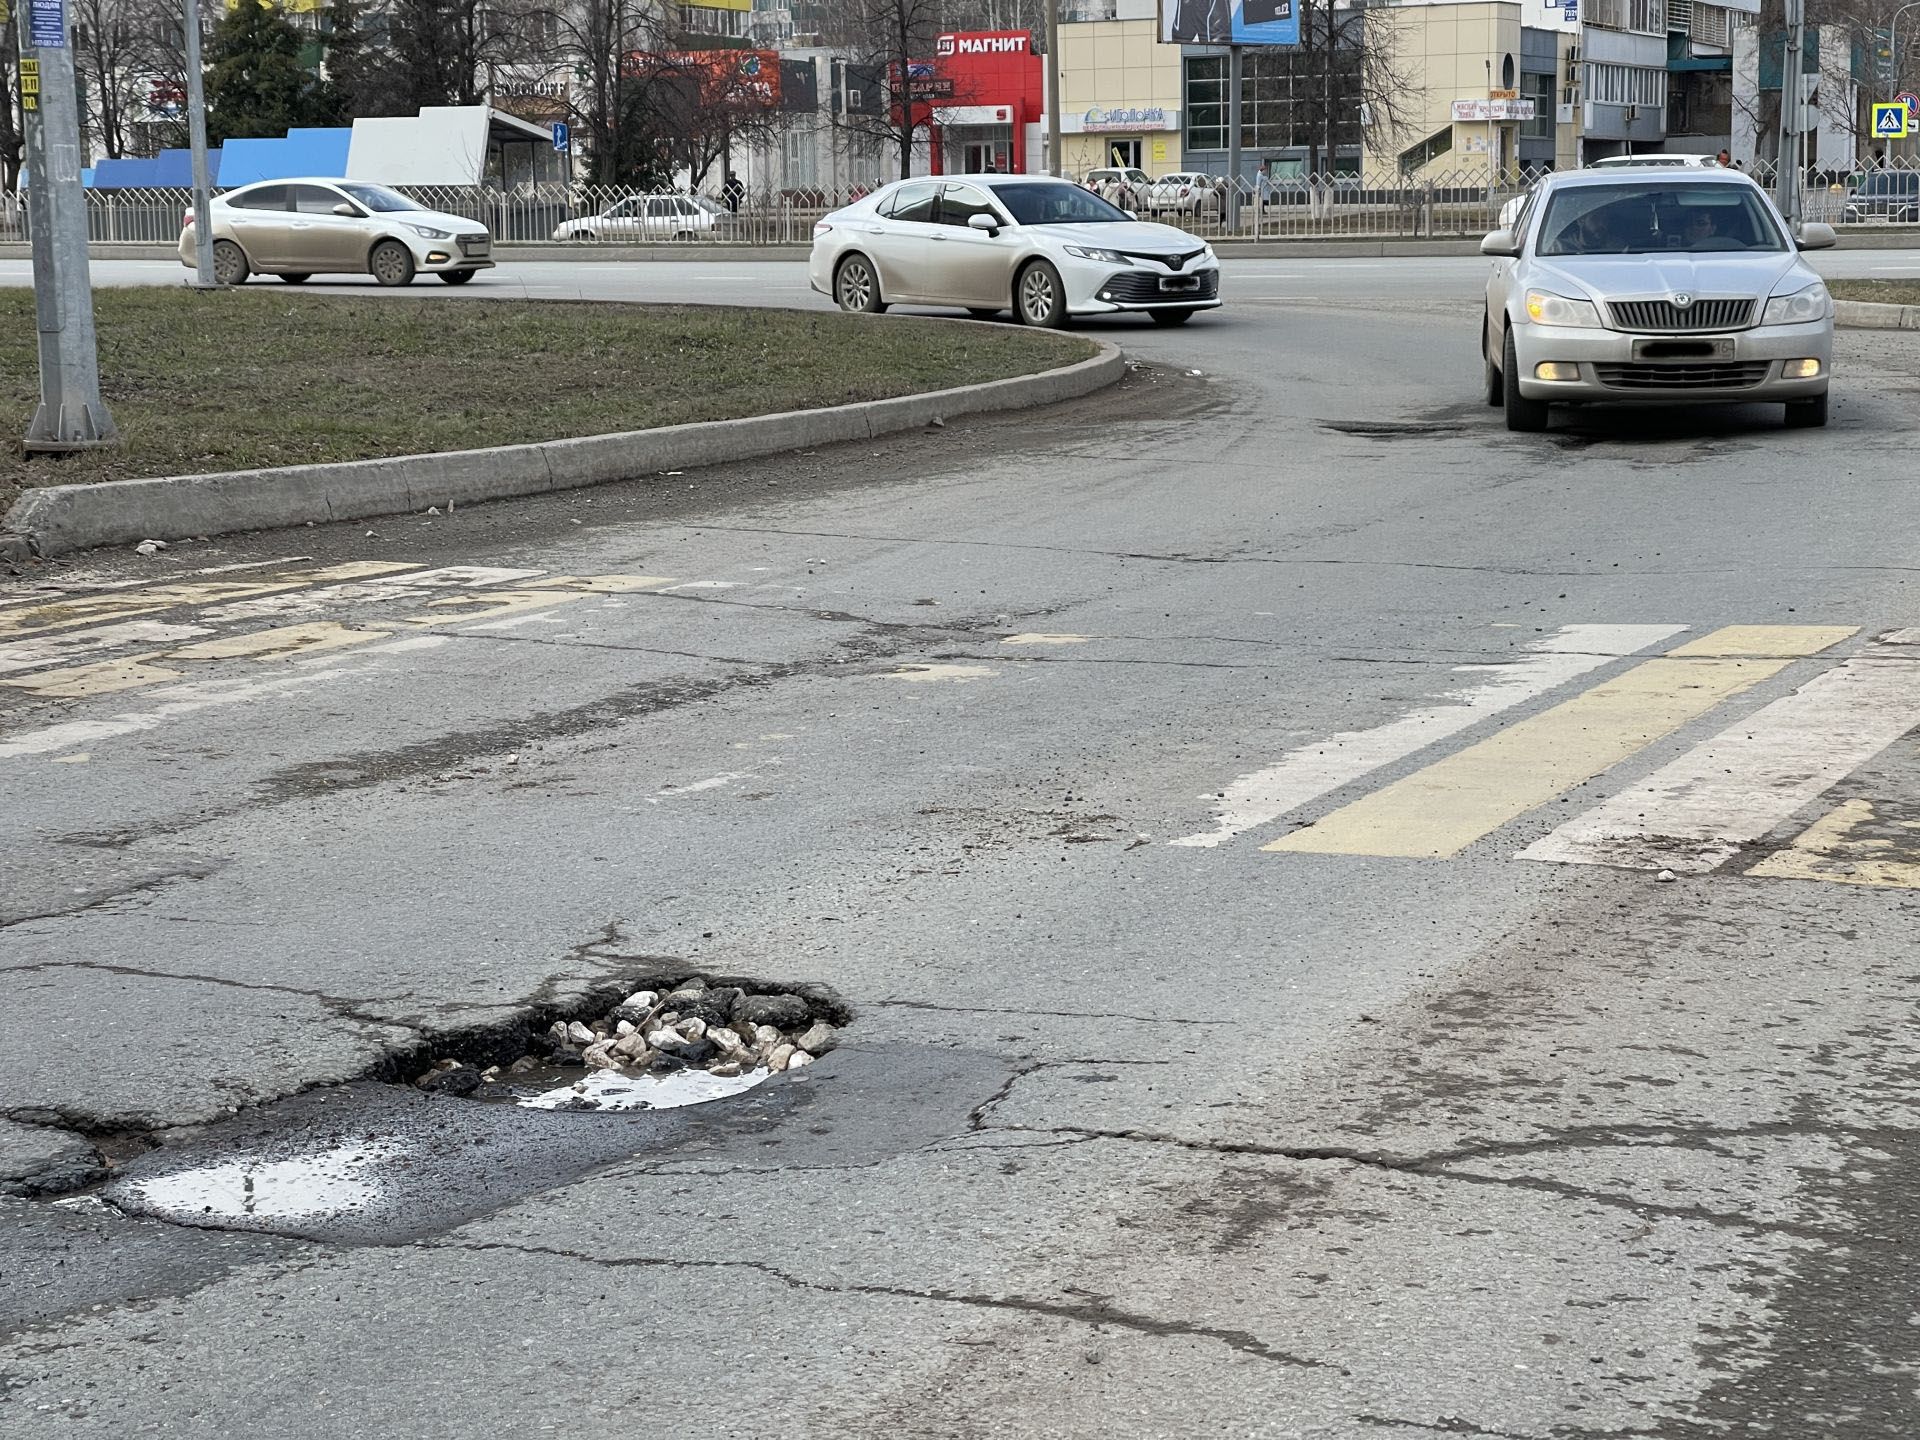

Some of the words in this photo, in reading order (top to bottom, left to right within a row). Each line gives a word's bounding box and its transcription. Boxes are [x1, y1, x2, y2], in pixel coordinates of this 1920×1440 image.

[959, 36, 1026, 53] МАГНИТ
[1490, 90, 1516, 98] ОТКРЫТО
[1479, 104, 1504, 113] ПРОУКТЫ
